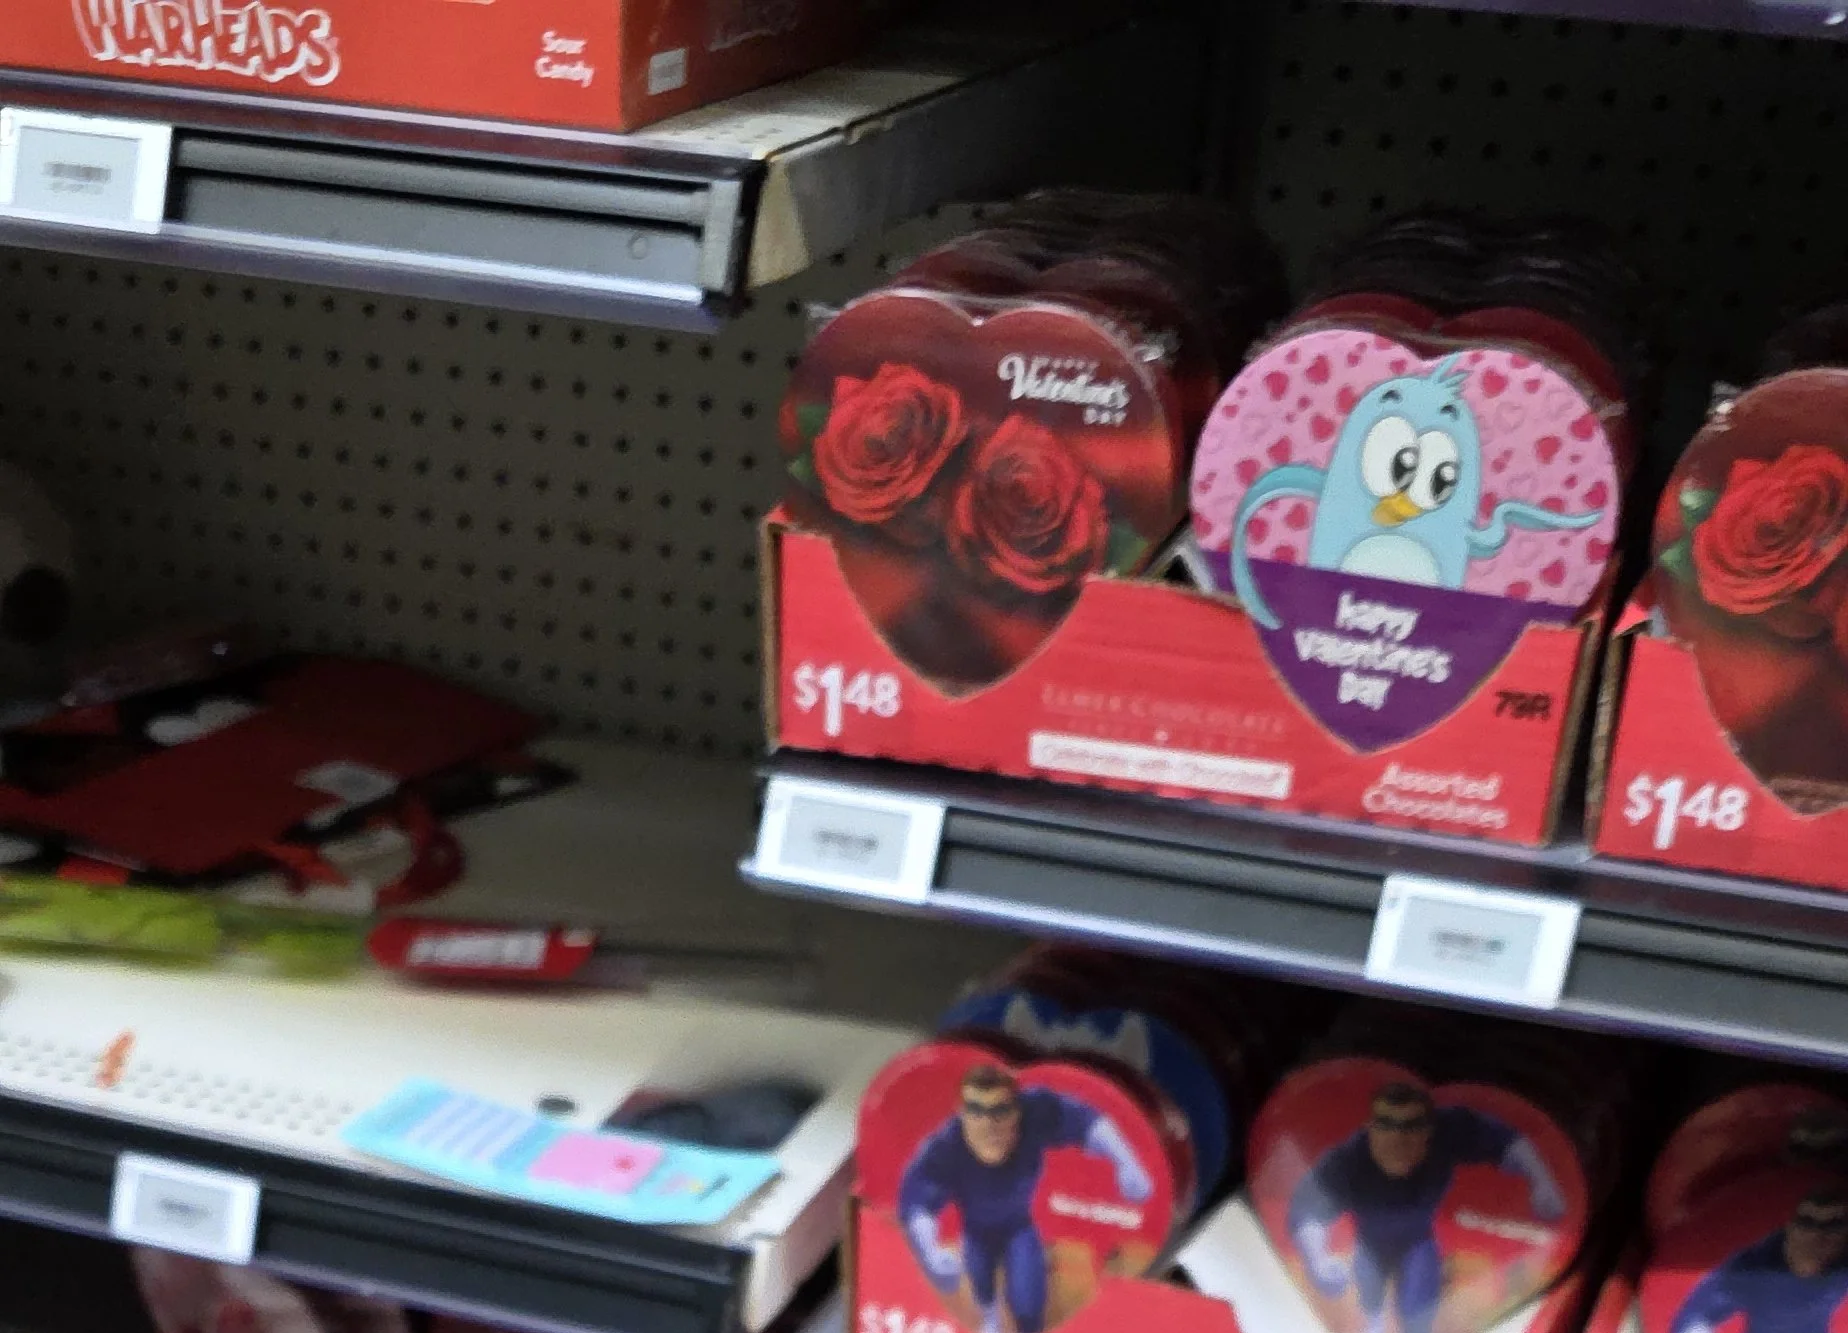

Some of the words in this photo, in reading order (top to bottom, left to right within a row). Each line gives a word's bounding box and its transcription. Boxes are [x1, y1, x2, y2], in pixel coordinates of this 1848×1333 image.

[540, 29, 588, 55] Sour
[534, 56, 596, 88] Candy
[1380, 761, 1503, 801] Assorted
[1362, 789, 1509, 830] Chocolates
